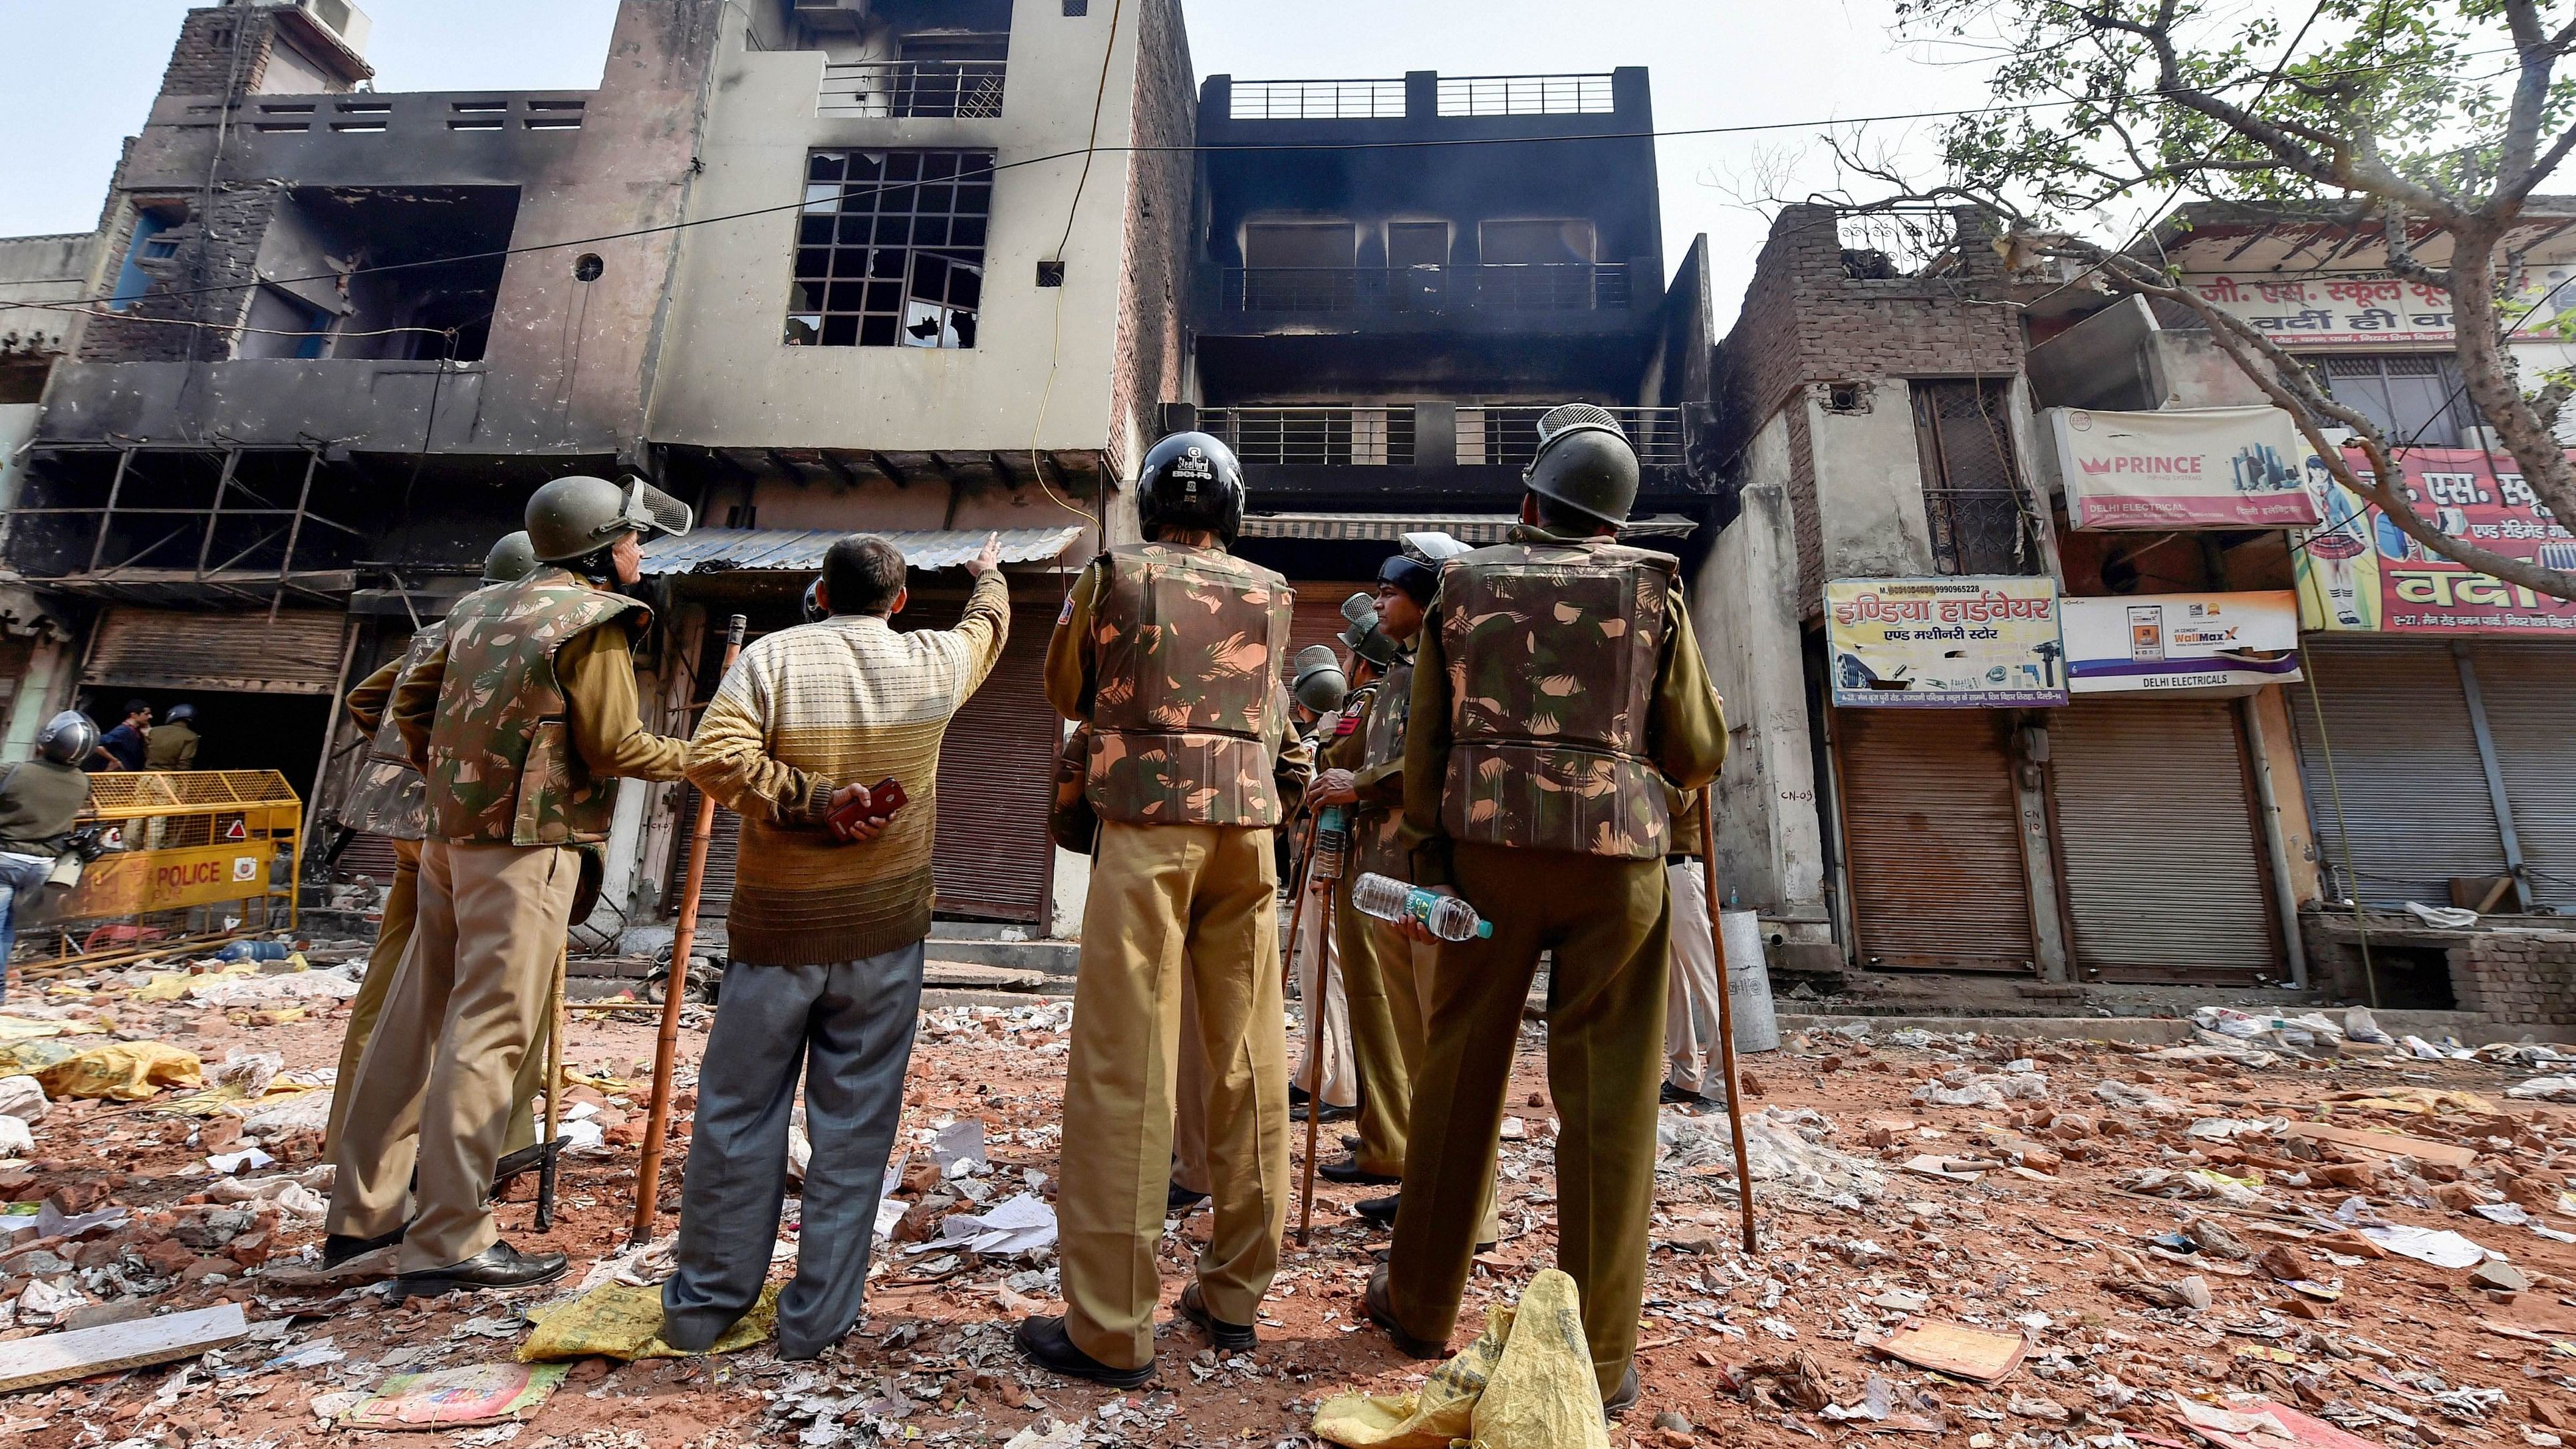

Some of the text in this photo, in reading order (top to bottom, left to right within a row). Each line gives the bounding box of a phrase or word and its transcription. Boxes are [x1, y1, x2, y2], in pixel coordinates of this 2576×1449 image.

[2324, 280, 2402, 309] स्कूल
[2345, 309, 2398, 330] ही
[1178, 456, 1209, 472] Steelbird
[2115, 456, 2202, 473] PRINCE
[2422, 472, 2490, 506] एस.
[2089, 503, 2186, 513] DELHI ELECTRICAL
[1833, 589, 2051, 625] इण्डिया हार्डवेयर
[1884, 626, 1999, 640] एण्ड मशीनरी स्टोर
[2142, 674, 2228, 688] DELHI ELECTRICALS
[2024, 810, 2040, 820] CN
[156, 861, 221, 888] POLICE
